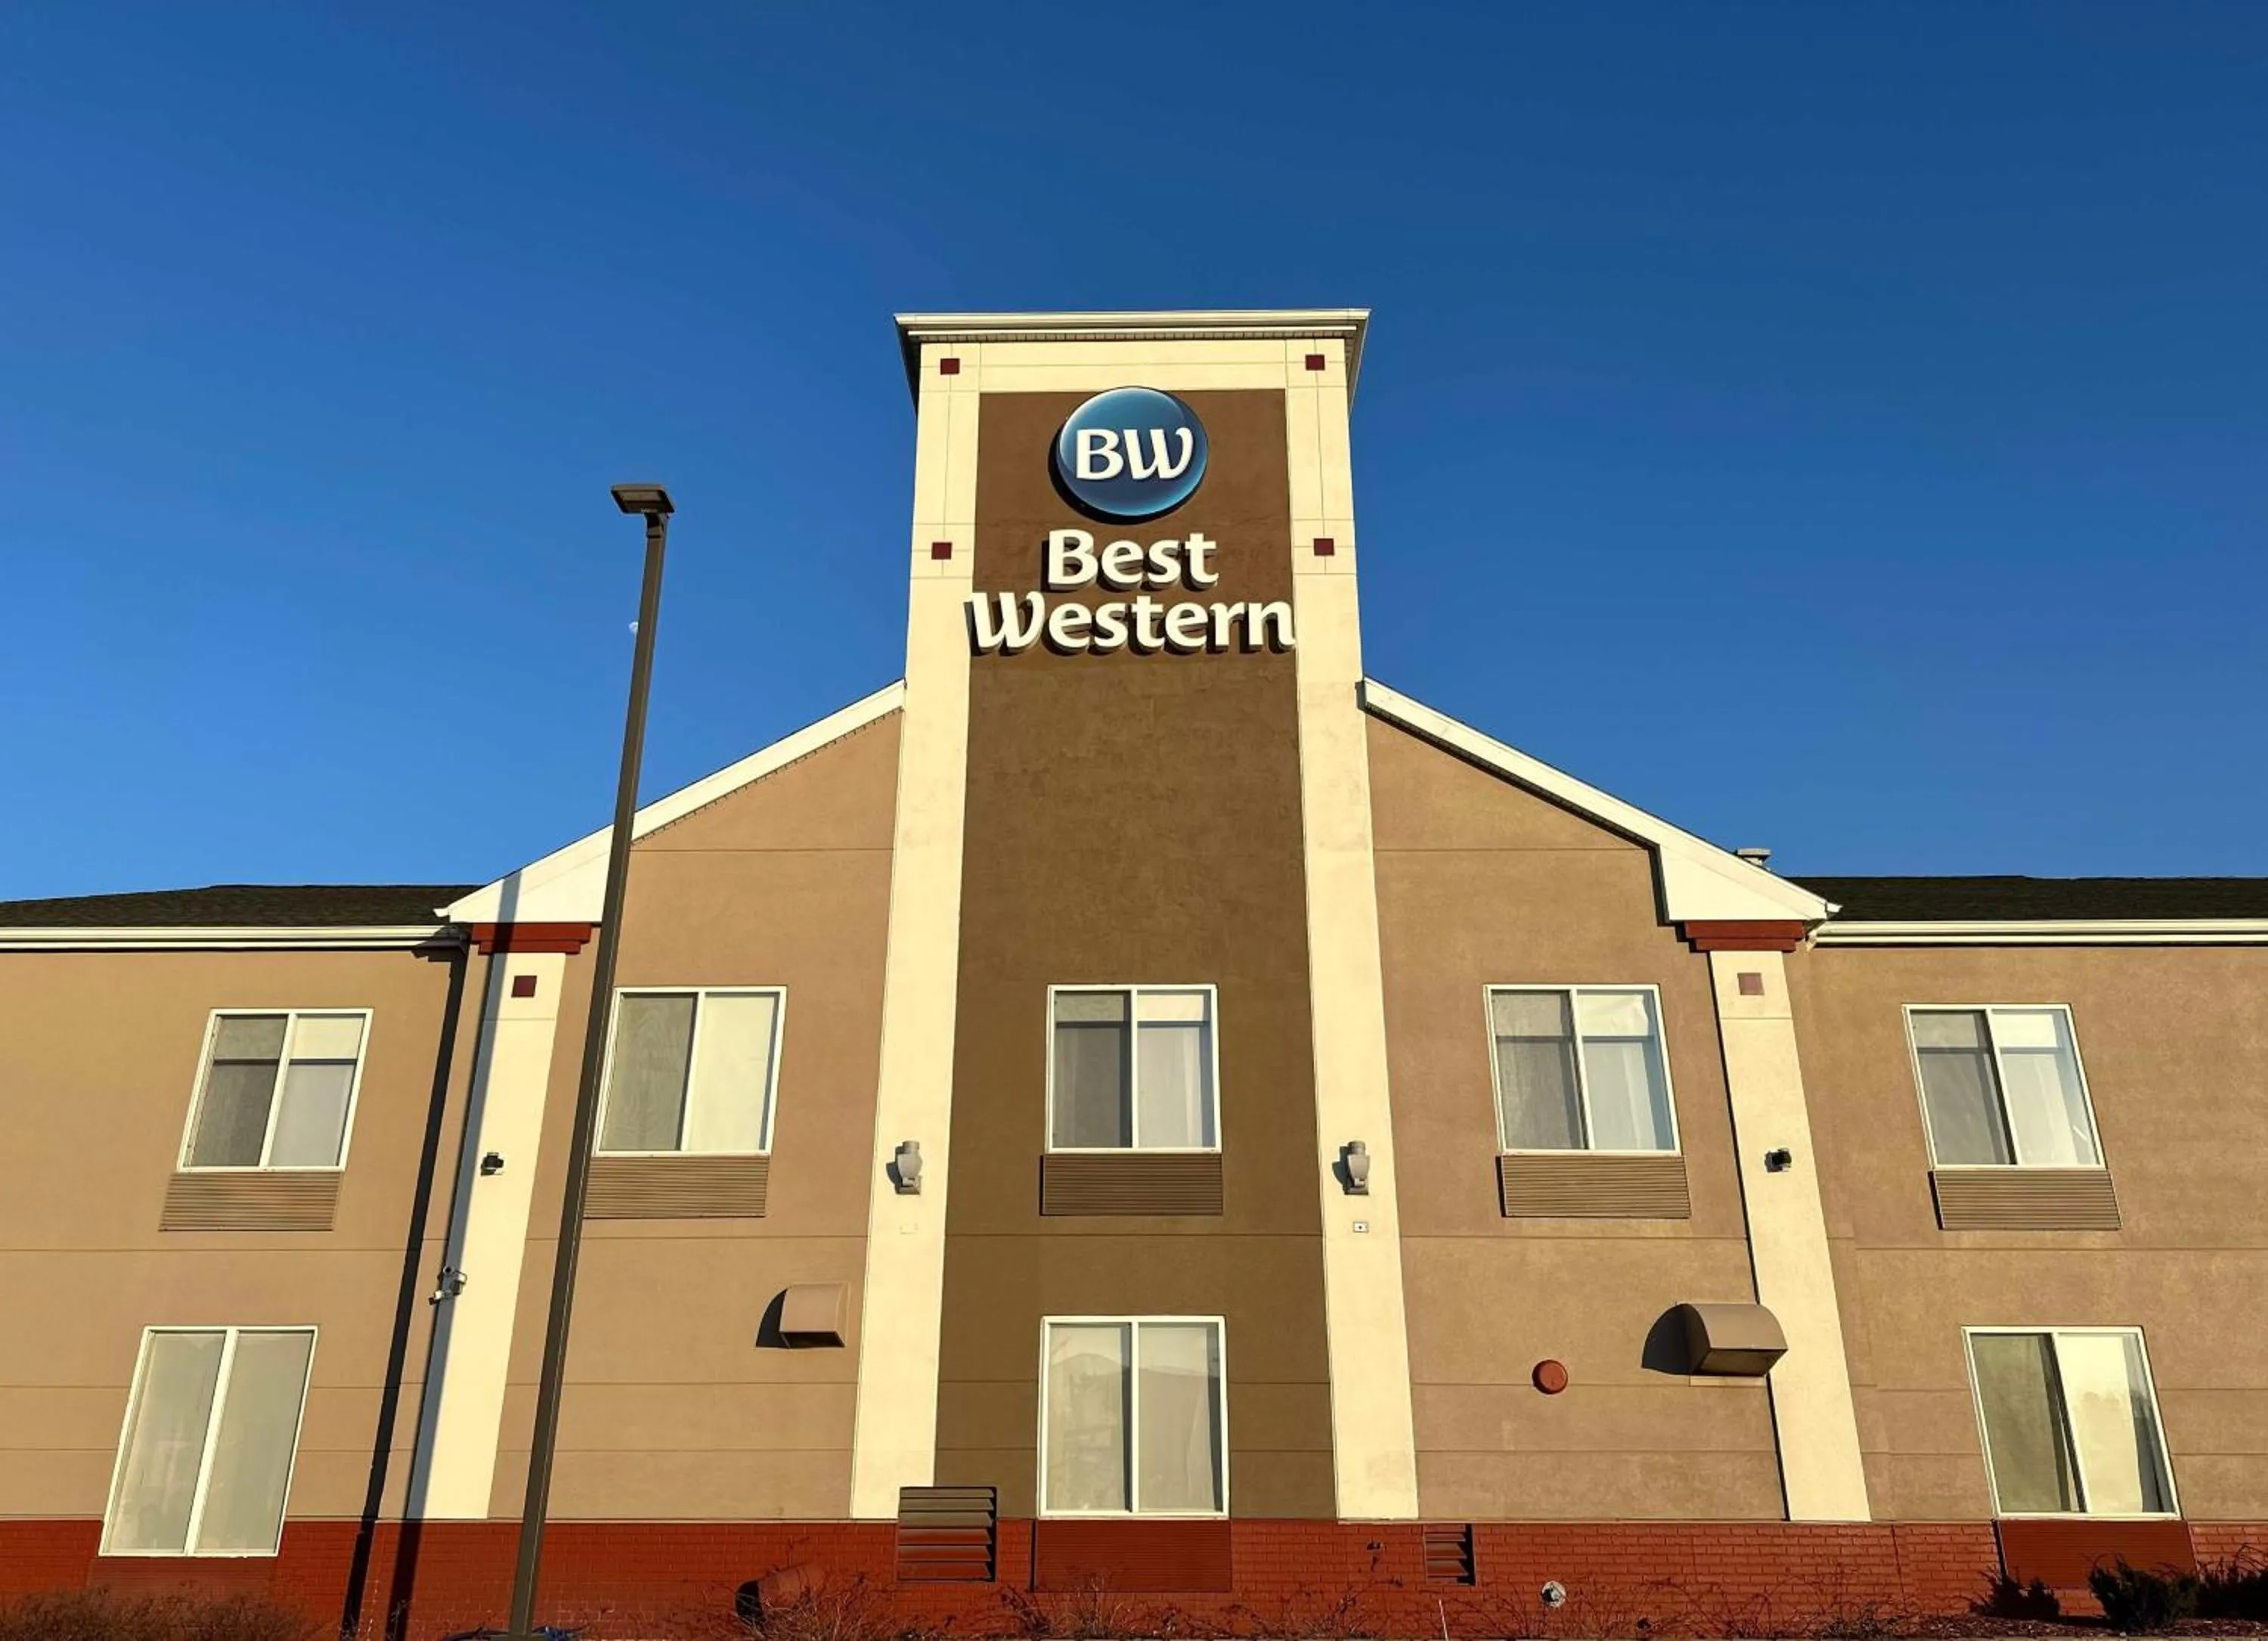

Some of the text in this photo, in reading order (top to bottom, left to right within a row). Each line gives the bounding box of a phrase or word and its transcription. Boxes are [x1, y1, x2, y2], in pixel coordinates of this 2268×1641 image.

[1076, 427, 1194, 480] BW
[1047, 529, 1219, 588] Best
[967, 591, 1296, 651] Western
